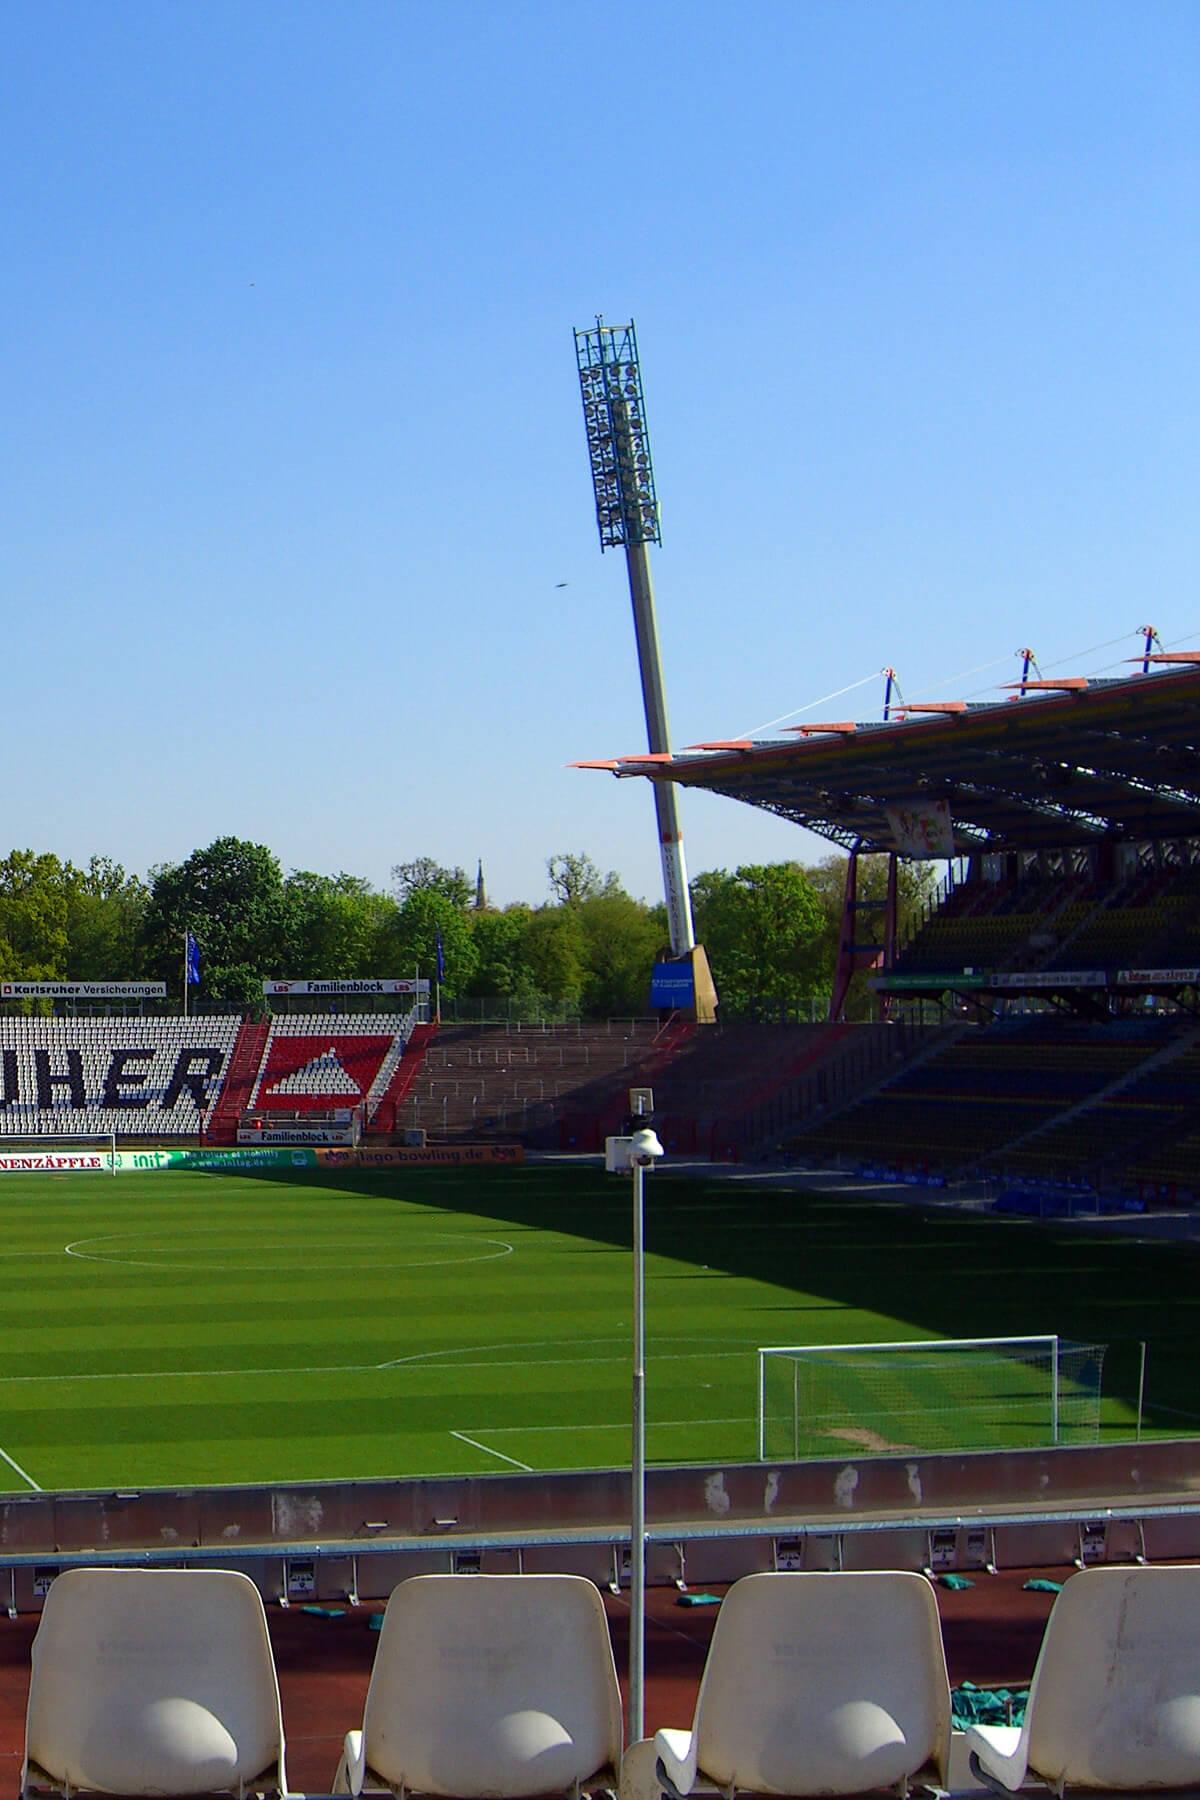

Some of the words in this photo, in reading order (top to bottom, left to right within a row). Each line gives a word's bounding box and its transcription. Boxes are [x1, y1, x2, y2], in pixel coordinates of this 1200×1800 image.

[14, 985, 80, 994] Karlsruher
[83, 985, 164, 995] Versicherungen
[307, 981, 383, 992] Familienblock
[261, 1131, 328, 1142] Familienblock
[133, 1153, 162, 1168] init
